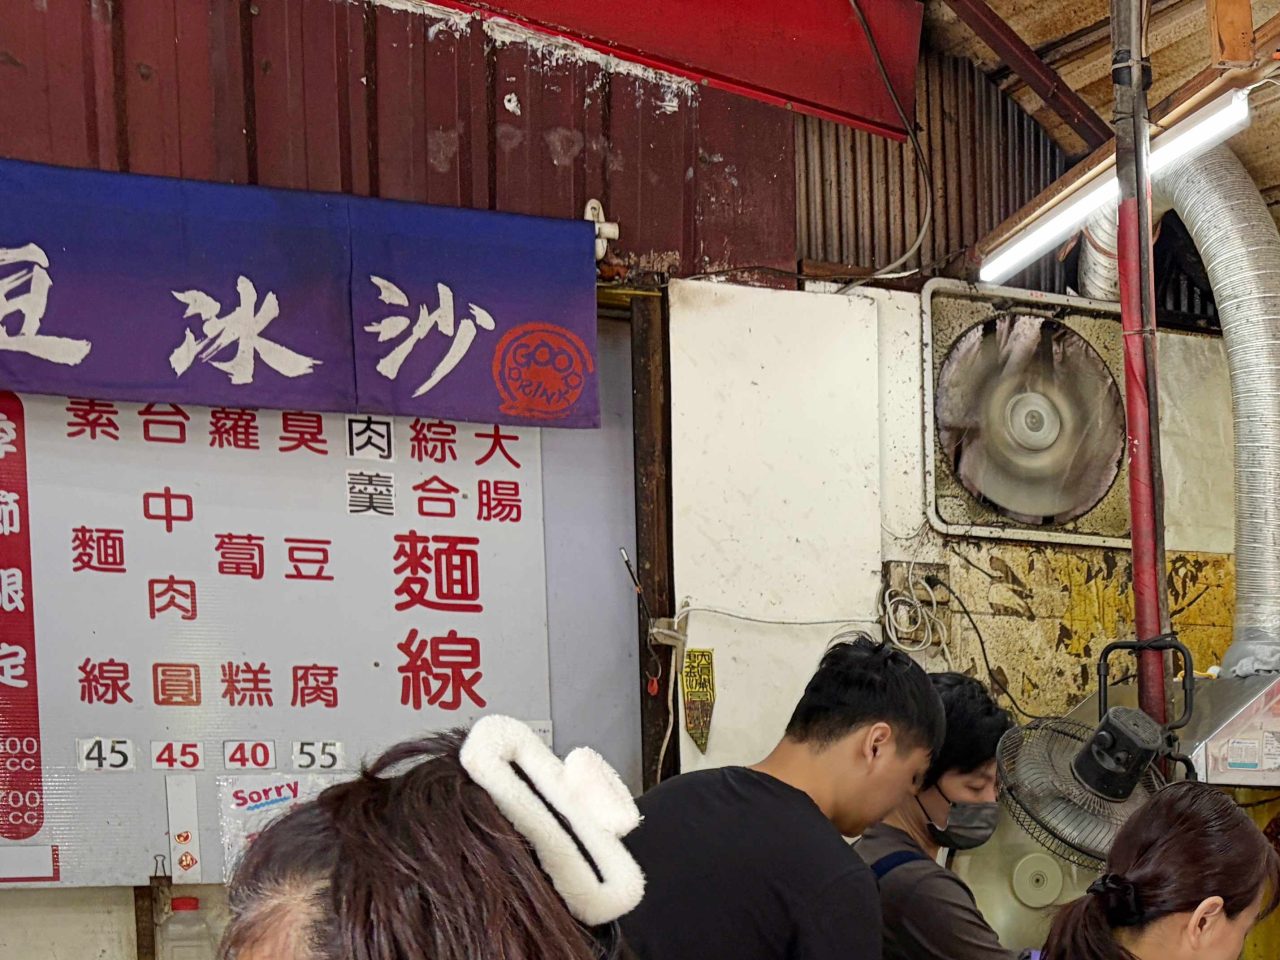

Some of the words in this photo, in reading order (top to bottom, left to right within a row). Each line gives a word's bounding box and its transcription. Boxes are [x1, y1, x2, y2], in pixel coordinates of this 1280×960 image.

[508, 366, 571, 407] DRINK
[512, 340, 583, 390] GOOD
[348, 416, 395, 516] 肉羹
[408, 418, 460, 519] 綜合
[473, 425, 523, 523] 大腸
[65, 399, 135, 705] 素麵線
[137, 402, 202, 707] 台中肉圓
[208, 410, 275, 708] 蘿蔔糕
[277, 411, 341, 709] 臭豆腐
[392, 531, 488, 711] 麵線
[0, 736, 38, 755] 00
[85, 740, 130, 768] 45
[155, 742, 200, 769] 45
[228, 742, 270, 768] 40
[298, 741, 338, 769] 55
[0, 790, 41, 808] 00
[231, 780, 299, 807] Sorry
